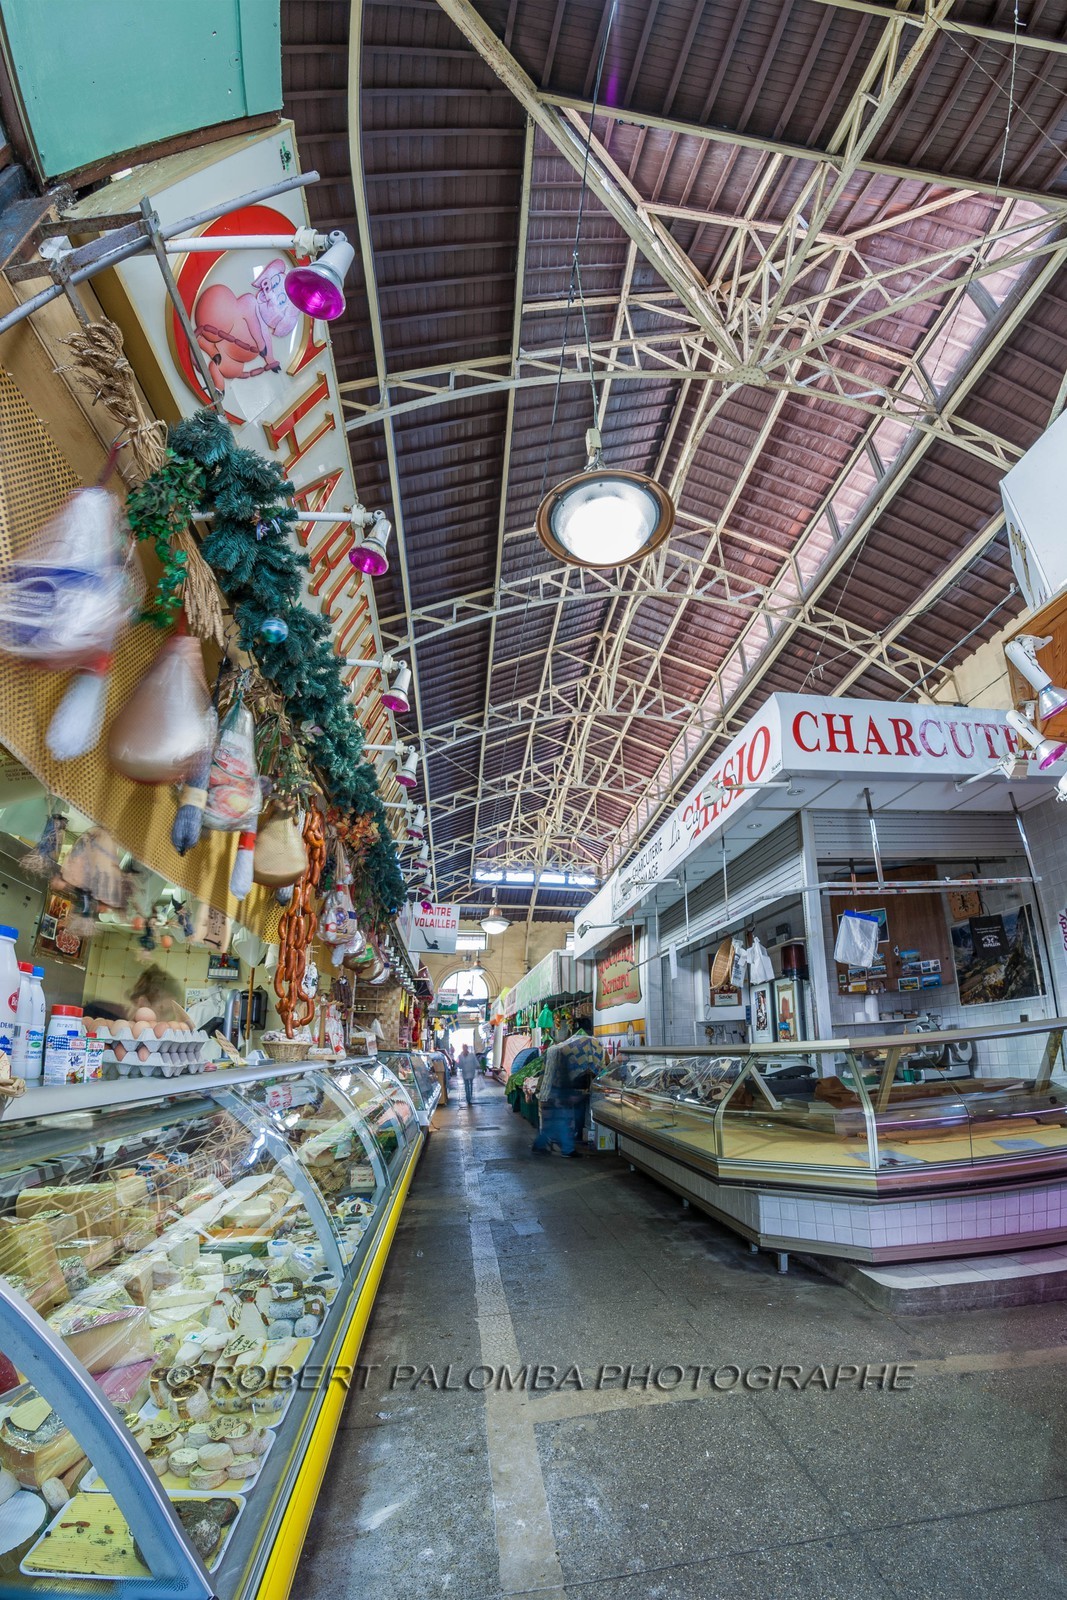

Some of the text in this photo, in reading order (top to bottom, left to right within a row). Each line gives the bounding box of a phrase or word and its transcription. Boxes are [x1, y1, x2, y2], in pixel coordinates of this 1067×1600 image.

[792, 710, 1037, 761] CHARCUTE
[421, 906, 452, 917] MAITRE
[414, 917, 457, 929] VOLAILLER
